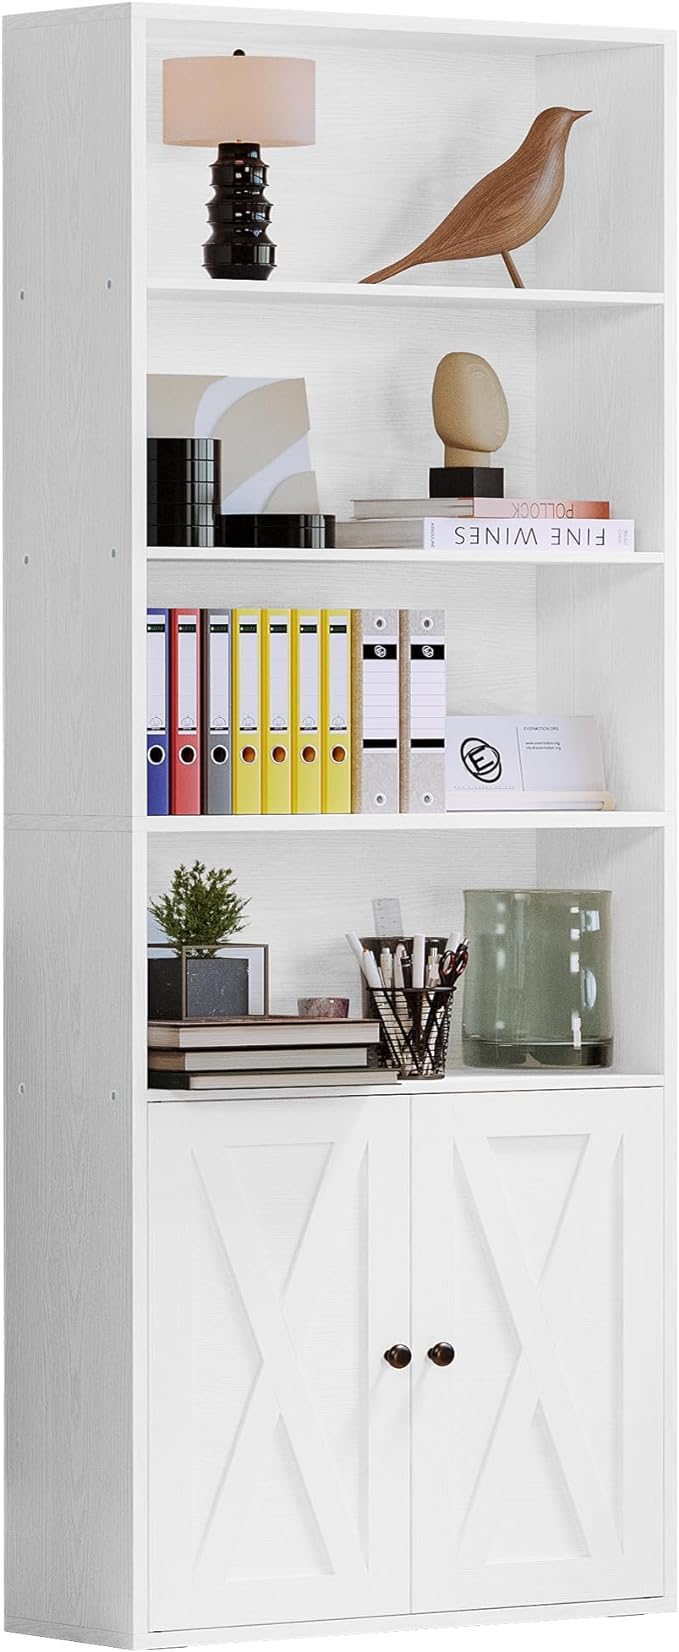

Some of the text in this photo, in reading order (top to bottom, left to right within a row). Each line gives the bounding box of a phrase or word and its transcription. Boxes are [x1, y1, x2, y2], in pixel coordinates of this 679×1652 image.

[512, 502, 574, 519] POLLOCK
[454, 526, 538, 546] WINES
[551, 527, 606, 546] FINE
